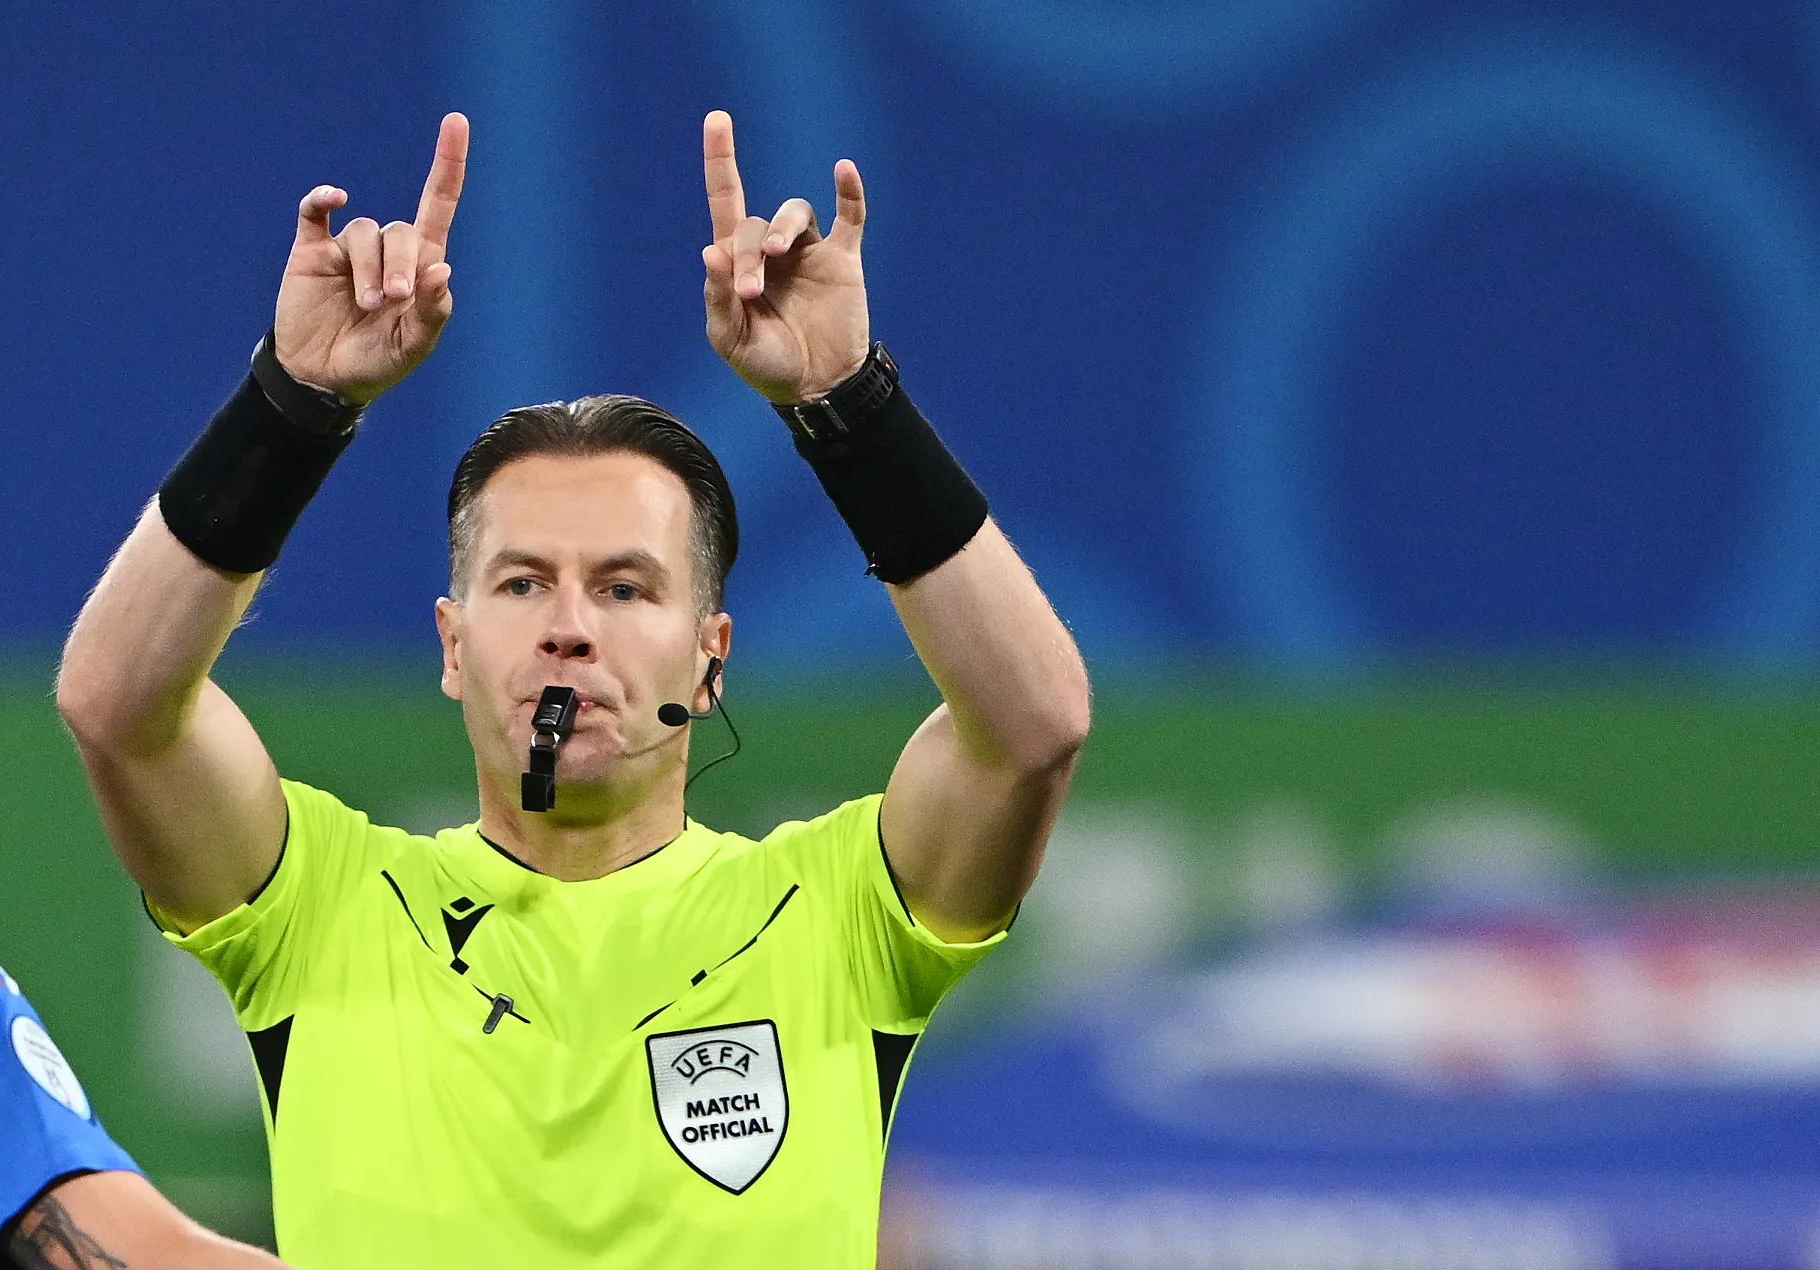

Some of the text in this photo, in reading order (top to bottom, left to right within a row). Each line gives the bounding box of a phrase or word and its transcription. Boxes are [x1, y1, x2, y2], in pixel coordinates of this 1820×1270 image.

[676, 1046, 750, 1078] UEFA
[687, 1093, 760, 1118] MATCH
[681, 1116, 774, 1143] OFFICIAL
